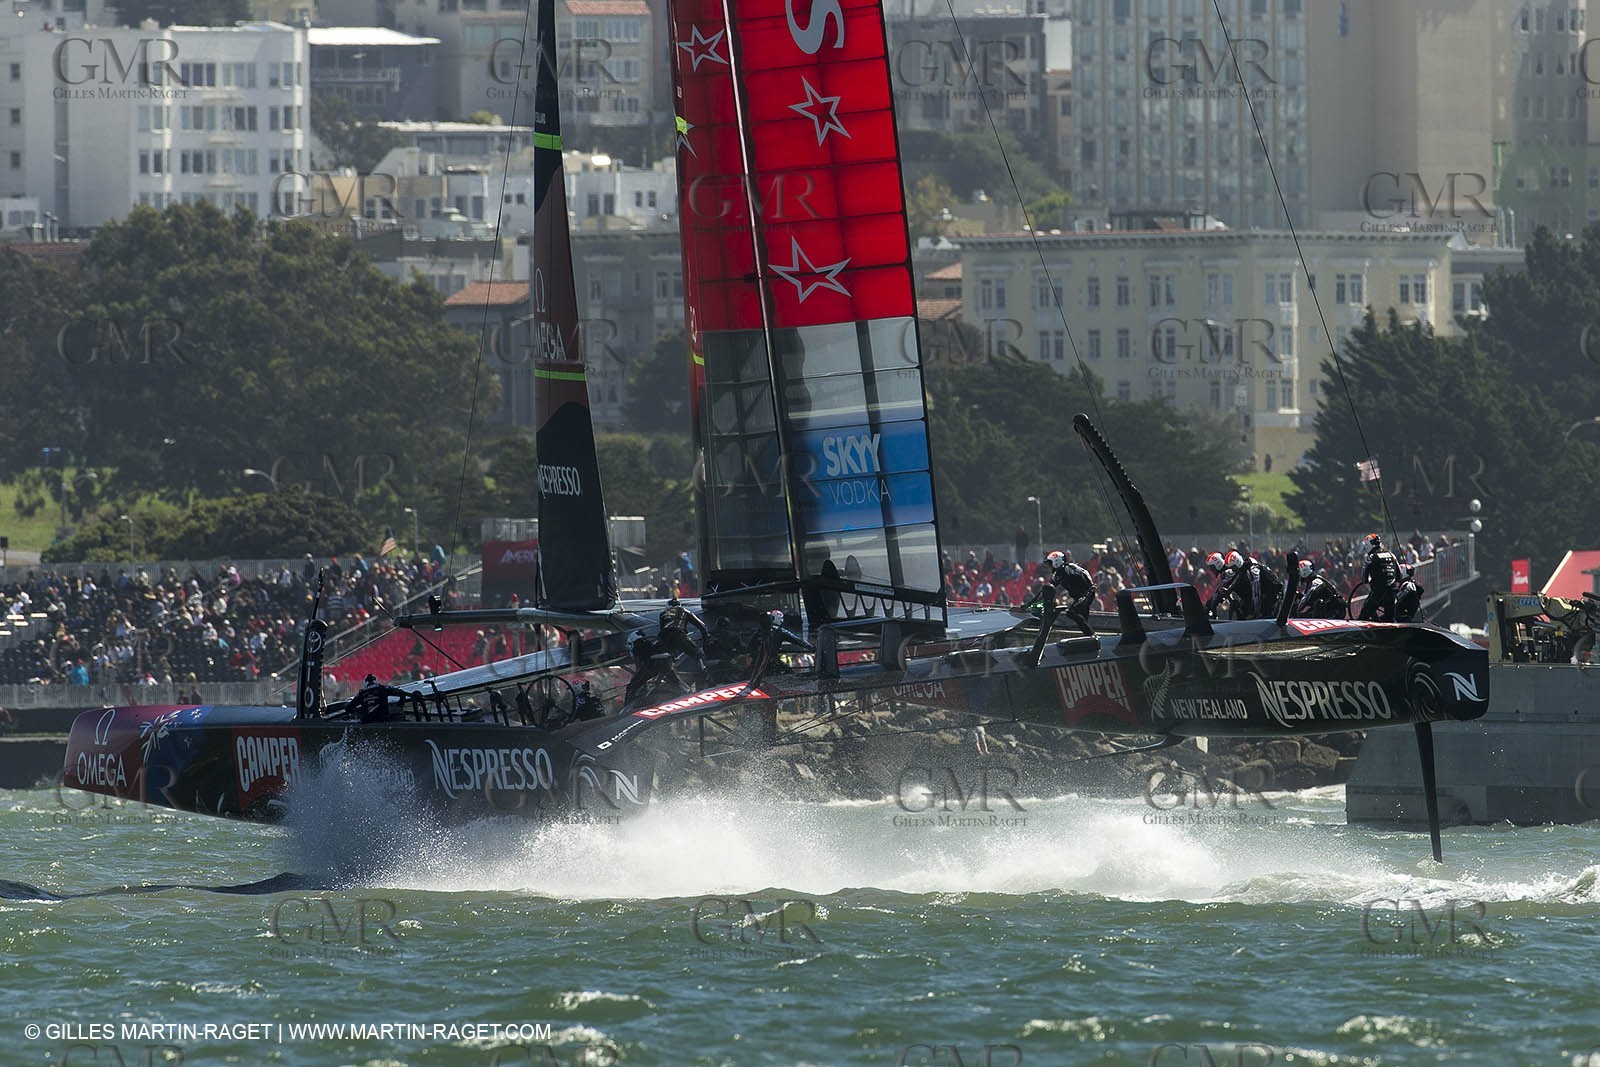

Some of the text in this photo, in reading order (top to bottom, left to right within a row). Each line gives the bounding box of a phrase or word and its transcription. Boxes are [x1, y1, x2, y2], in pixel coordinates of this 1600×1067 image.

[823, 433, 880, 476] SKYY
[537, 465, 581, 499] NESPRESSO
[829, 480, 892, 504] VODKA
[1056, 662, 1131, 712] CAMPER
[1248, 672, 1392, 728] NESPRESSO
[1443, 673, 1488, 701] N
[1170, 699, 1248, 720] NEW ZEALAND
[77, 752, 127, 787] OMEGA
[236, 736, 299, 791] CAMPER
[424, 739, 553, 799] NESPRESSO
